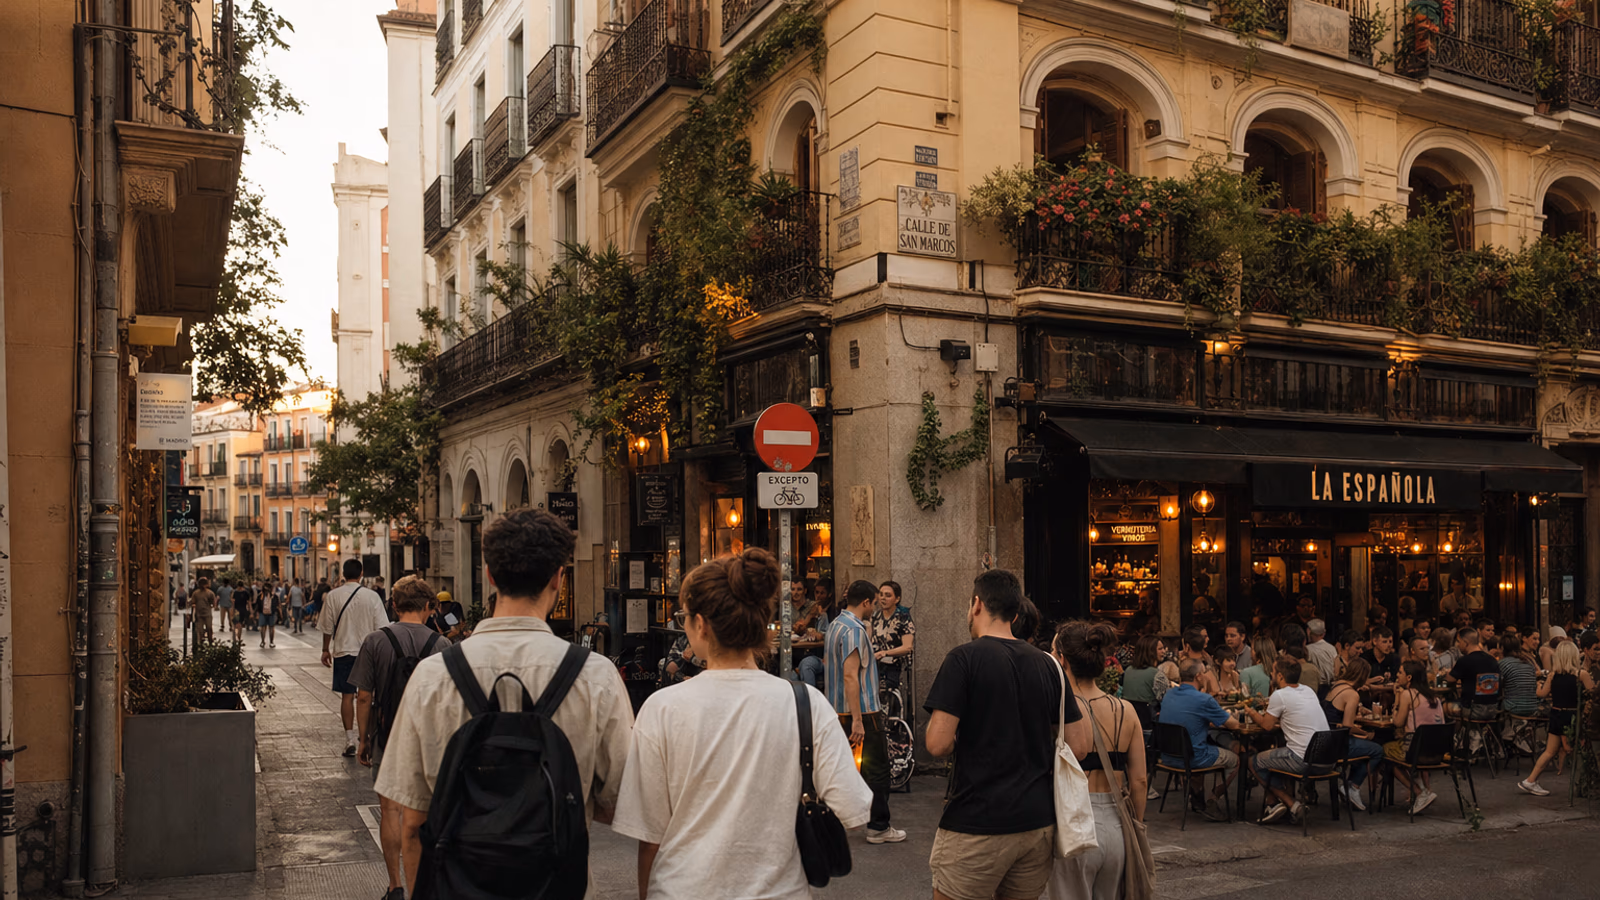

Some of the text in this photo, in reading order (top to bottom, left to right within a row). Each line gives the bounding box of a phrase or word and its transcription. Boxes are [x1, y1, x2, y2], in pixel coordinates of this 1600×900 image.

[905, 217, 951, 237] CALLE DE
[899, 233, 956, 254] SAN MARCOS
[768, 476, 809, 484] EXCEPTO
[1311, 470, 1436, 504] LA ESPAÑOLA
